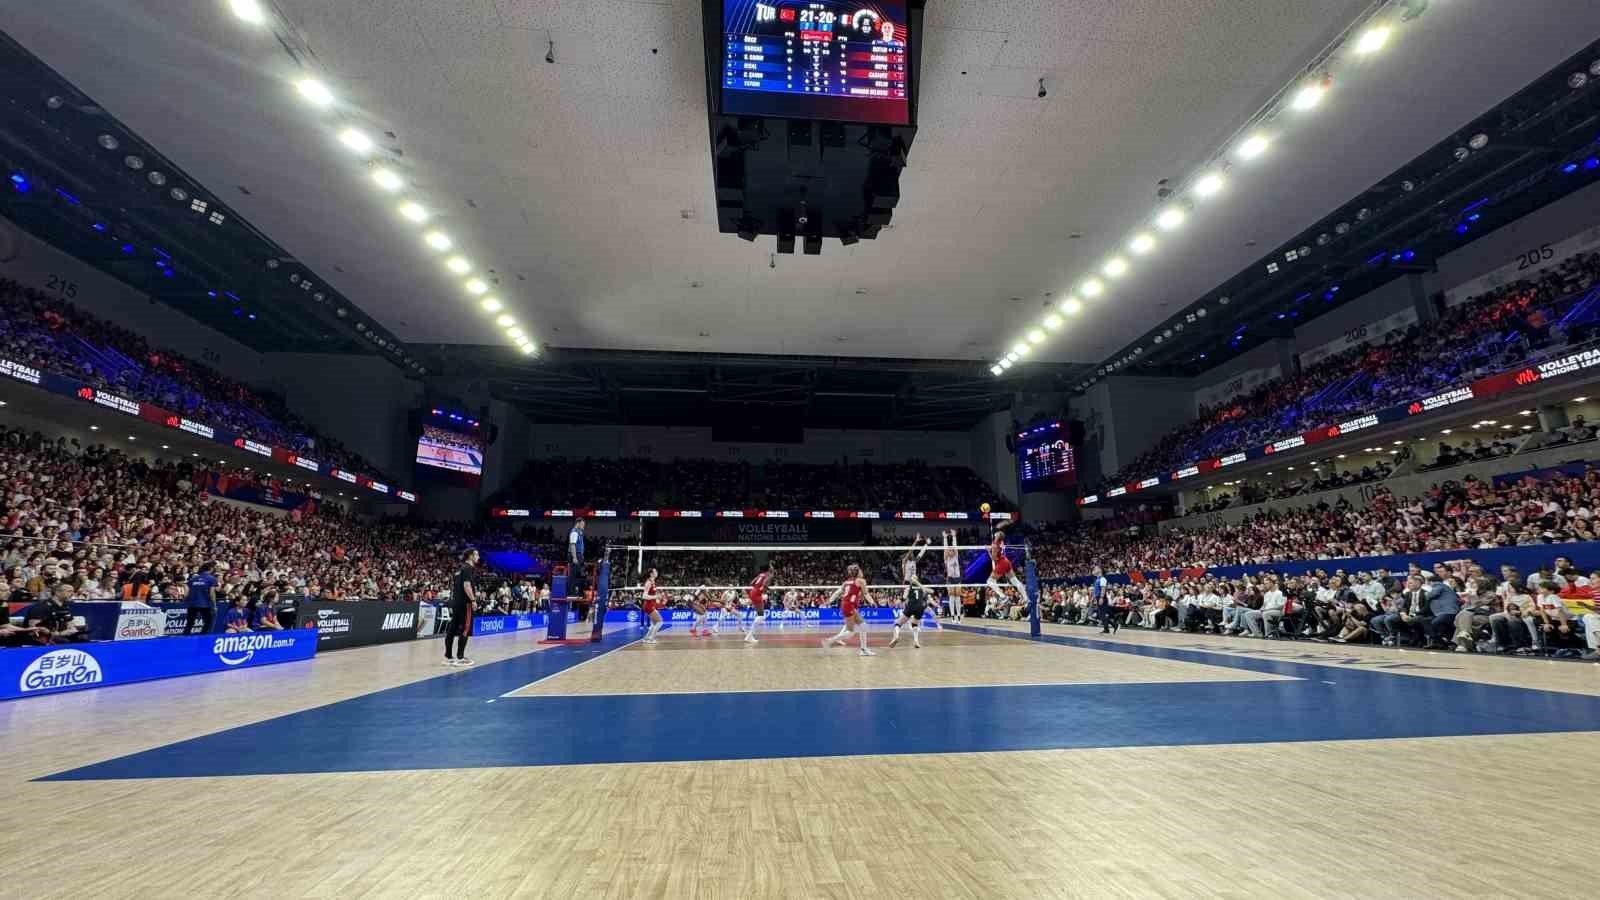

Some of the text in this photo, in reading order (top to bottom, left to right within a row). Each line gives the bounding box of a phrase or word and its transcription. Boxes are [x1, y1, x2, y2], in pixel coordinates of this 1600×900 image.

[756, 3, 776, 21] TUR
[1515, 243, 1554, 271] 205
[46, 274, 79, 298] 215
[1540, 364, 1580, 380] NATIONS
[96, 390, 140, 410] VOLLEYBALL
[1422, 386, 1472, 405] VOLLEYBALL
[738, 524, 808, 533] VOLLEYBALL
[317, 619, 350, 627] VOLLEYBALL
[382, 613, 415, 630] ANKARA
[480, 617, 504, 632] trendyol
[213, 634, 296, 654] amazon.com.tr
[40, 653, 86, 670] 百岁山
